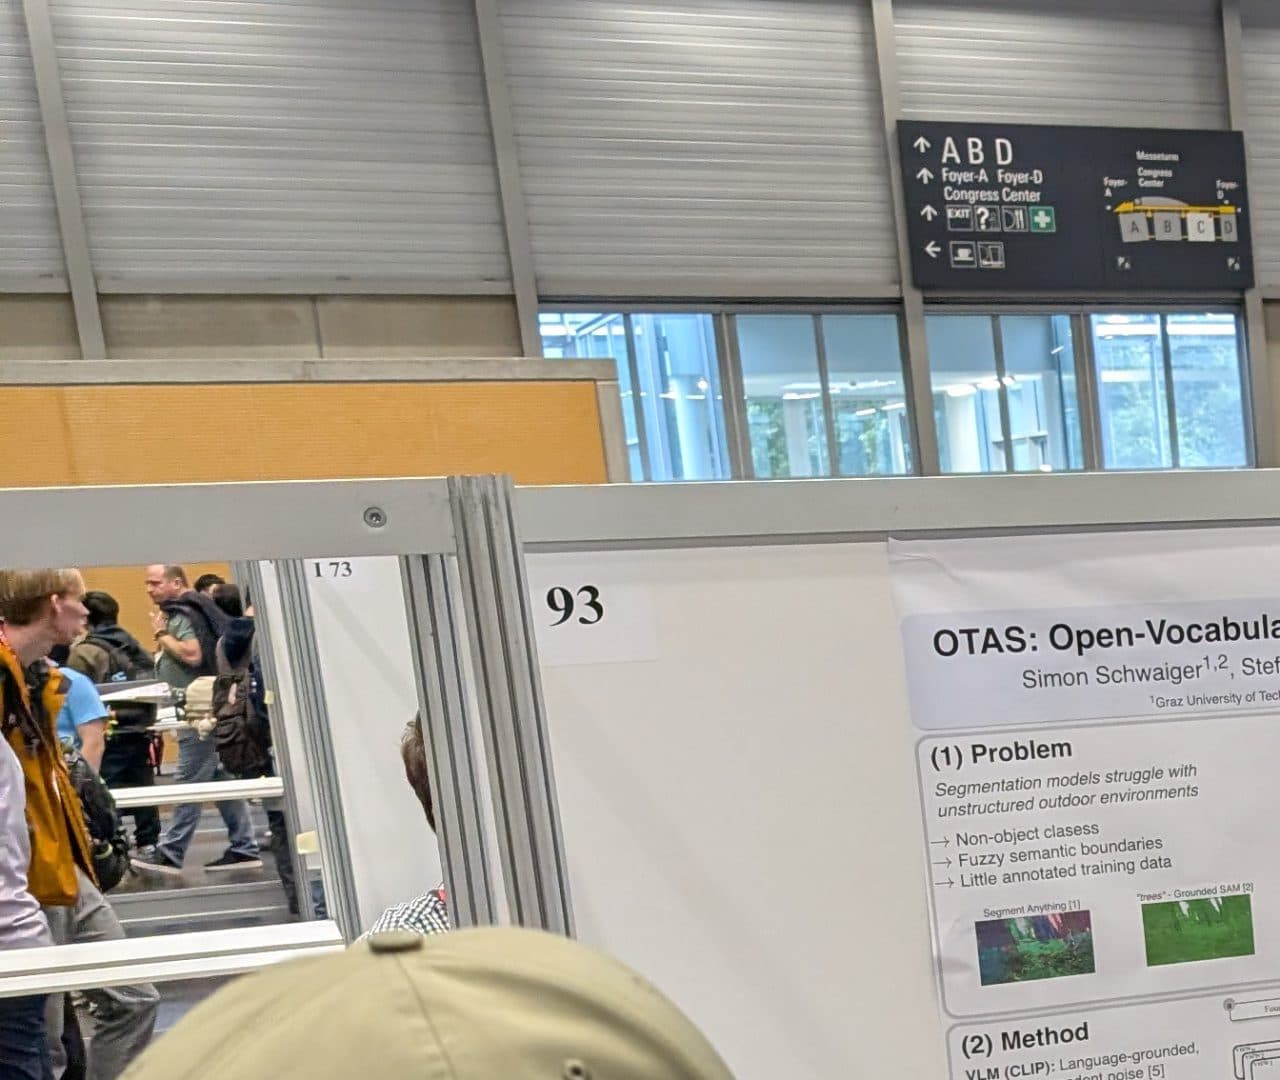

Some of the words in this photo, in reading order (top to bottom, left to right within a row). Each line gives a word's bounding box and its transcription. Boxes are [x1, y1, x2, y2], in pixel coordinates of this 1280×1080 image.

[942, 137, 961, 163] A
[967, 137, 984, 164] B
[995, 138, 1013, 165] D
[942, 168, 988, 184] Foyer-A
[997, 169, 1043, 186] Foyer-D
[944, 186, 999, 204] Congress
[1002, 188, 1041, 202] Center
[948, 209, 970, 218] EXIT
[1131, 221, 1139, 233] A
[1165, 220, 1172, 233] B
[1197, 221, 1205, 233] C
[1224, 221, 1232, 233] D
[314, 562, 321, 577] I
[329, 562, 352, 577] 73
[546, 585, 604, 627] 93
[933, 626, 1037, 656] OTAS:
[1023, 669, 1088, 688] Simon
[1187, 693, 1242, 706] University
[1245, 691, 1256, 702] of
[931, 745, 962, 772] (1)
[971, 740, 1072, 764] Problem
[935, 776, 1041, 798] Segmentation
[1047, 771, 1100, 788] models
[1105, 766, 1164, 784] struggle
[1168, 764, 1197, 778] with
[938, 796, 1034, 817] unstructured
[1039, 794, 1096, 809] outdoor
[1100, 785, 1198, 804] environments
[956, 827, 1040, 846] Non-object
[1044, 824, 1099, 838] clasess
[959, 853, 1004, 867] Fuzzy
[1010, 844, 1076, 862] semantic
[1081, 837, 1163, 855] boundaries
[960, 872, 997, 887] Little
[1002, 864, 1076, 884] annotated
[1081, 860, 1135, 876] training
[1140, 856, 1172, 870] data
[984, 906, 1024, 917] Segment
[1028, 903, 1066, 912] Anything
[1068, 899, 1080, 909] [1]
[962, 1034, 992, 1059] (2)
[1002, 1022, 1088, 1050] Method
[1005, 1061, 1055, 1080] (CLIP):
[1060, 1042, 1199, 1070] Language-grounded,
